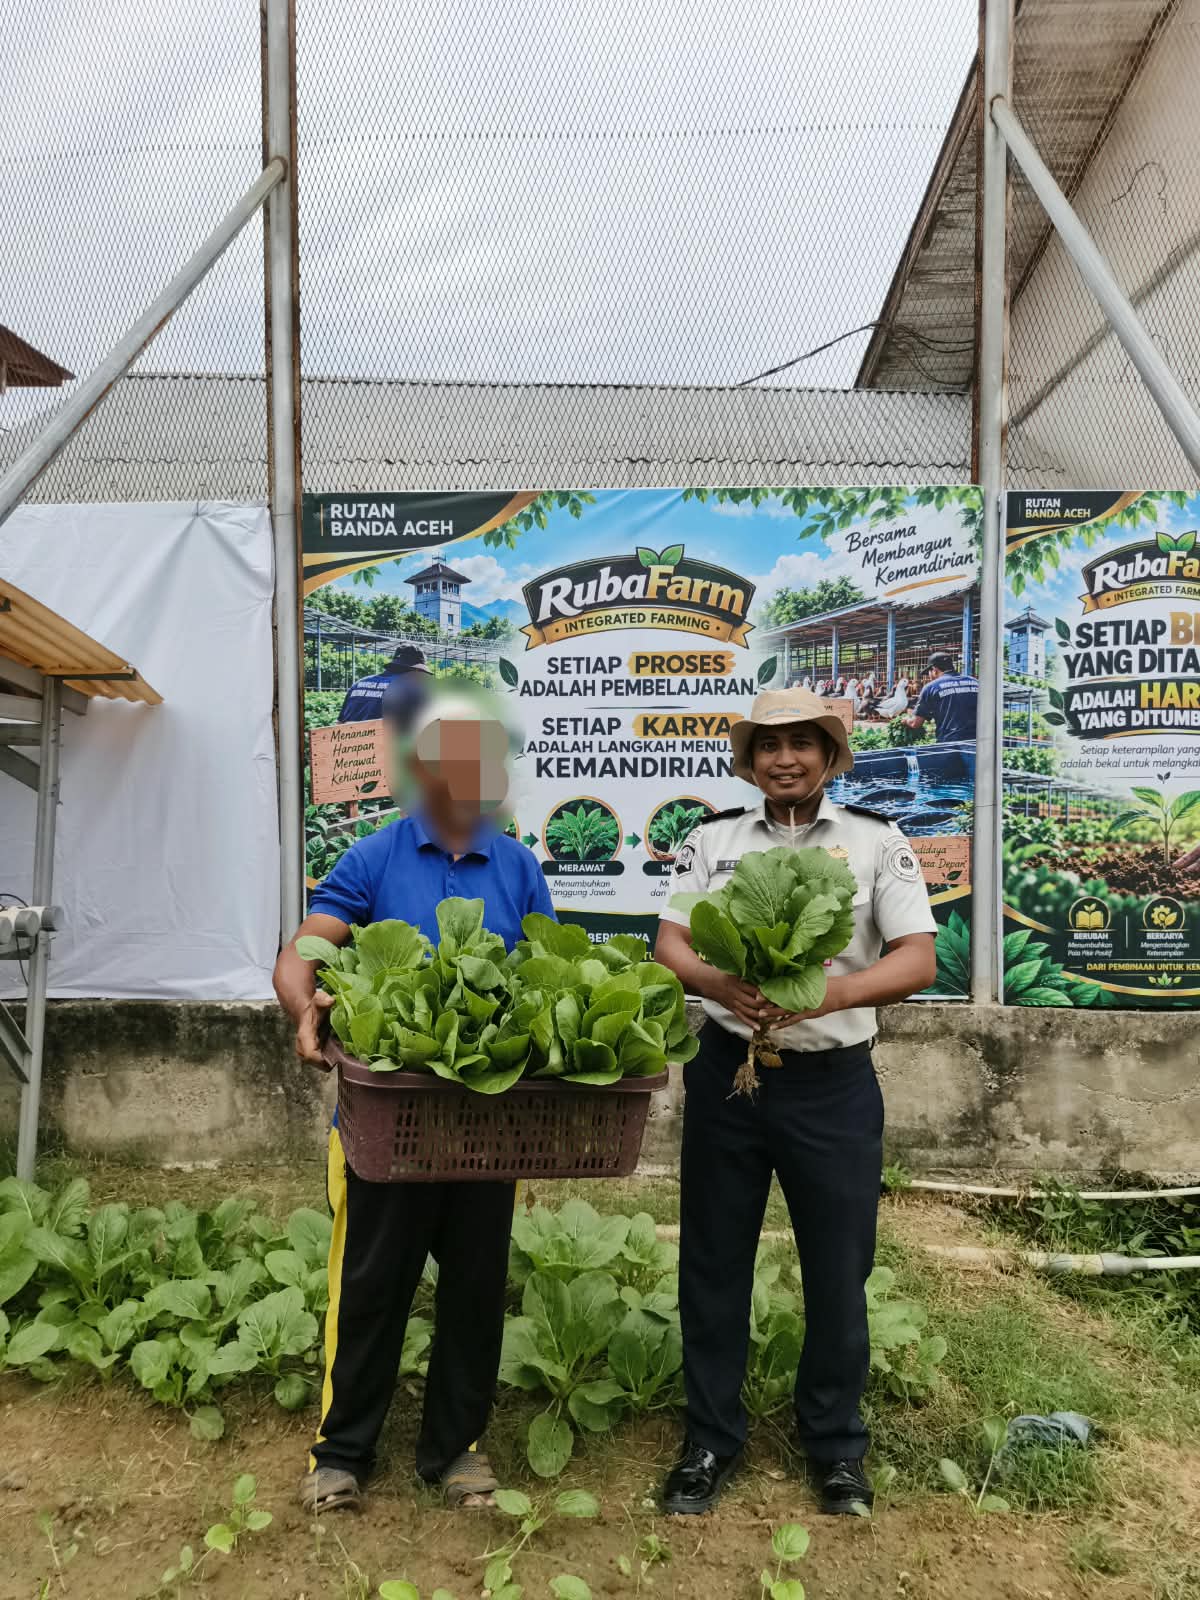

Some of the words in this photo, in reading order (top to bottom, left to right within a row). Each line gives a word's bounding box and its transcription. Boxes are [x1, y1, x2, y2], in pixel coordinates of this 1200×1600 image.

[331, 503, 395, 519] RUTAN
[1025, 498, 1061, 508] RUTAN
[1025, 508, 1061, 518] BANDA
[1064, 508, 1091, 518] ACEH
[331, 521, 398, 537] BANDA
[403, 520, 454, 536] ACEH
[845, 525, 917, 553] Bersama
[861, 536, 952, 568] Membangun
[875, 552, 975, 588] Kemandirian
[537, 565, 745, 623] RubaFarm
[1114, 585, 1172, 601] INTEGRATED
[564, 611, 645, 634] INTEGRATED
[650, 613, 711, 631] FARMING
[1075, 619, 1167, 648] SETIAP
[547, 656, 622, 675] SETIAP
[635, 654, 726, 674] PROSES
[1064, 650, 1132, 679] YANG
[520, 680, 596, 697] ADALAH
[602, 678, 758, 697] PEMBELAJARAN.
[1070, 690, 1136, 711] ADALAH
[542, 717, 622, 736] SETIAP
[642, 716, 731, 736] KARYA
[1077, 712, 1126, 730] YANG
[330, 727, 376, 743] Menanam
[333, 741, 375, 757] Harapan
[527, 741, 592, 754] ADALAH
[599, 740, 676, 753] LANGKAH
[1080, 745, 1109, 756] Setiap
[1112, 744, 1174, 756] keterampilan
[334, 754, 376, 769] Merawat
[536, 756, 735, 778] KEMANDIRIAN
[1060, 759, 1092, 768] adalah
[1095, 759, 1120, 768] bekal
[1123, 759, 1149, 768] untuk
[331, 768, 382, 785] Kehidupan
[558, 864, 606, 872] MERAWAT
[553, 880, 611, 888] Menumbuhkan
[589, 888, 616, 897] Jawab
[1086, 963, 1106, 971] DARI
[1108, 963, 1155, 971] PEMBINAAN
[1157, 963, 1184, 971] UNTUK
